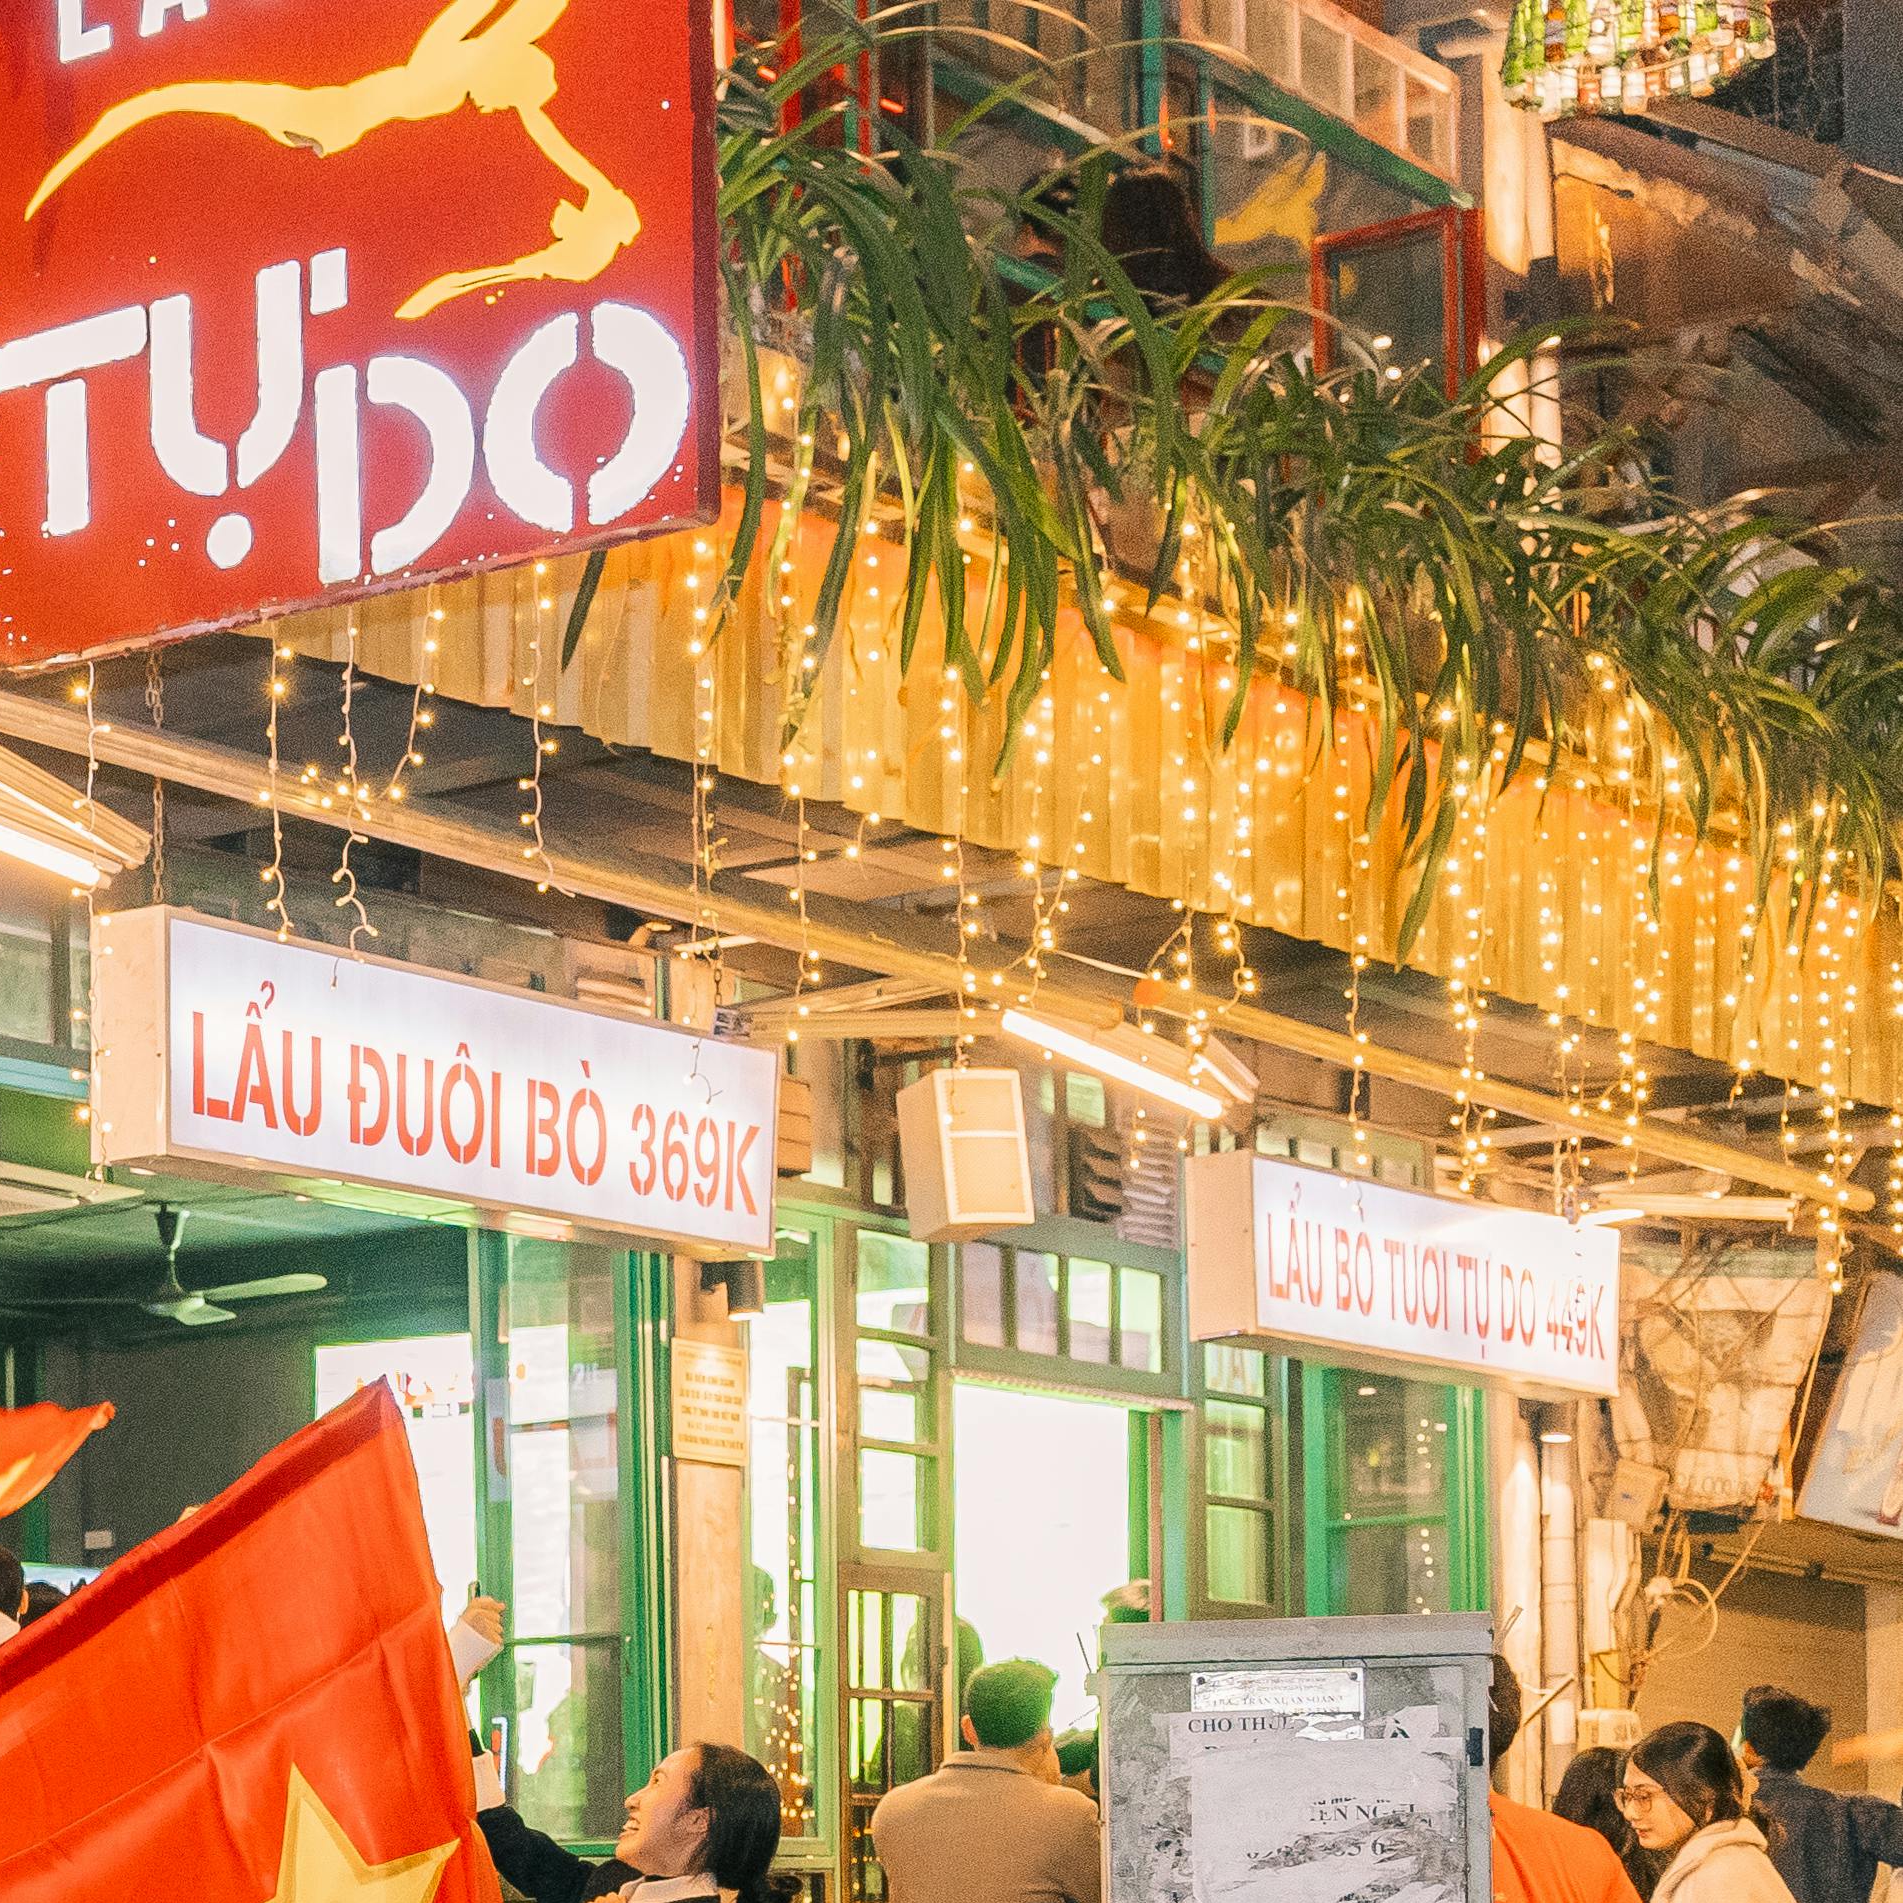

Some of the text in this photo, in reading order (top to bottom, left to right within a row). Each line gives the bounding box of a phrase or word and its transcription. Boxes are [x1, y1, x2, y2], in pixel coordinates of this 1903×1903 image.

[314, 302, 691, 584] DO
[191, 980, 761, 1216] LẨU ĐUÔI BÒ 369K
[1501, 1264, 1536, 1347] DO
[1188, 1718, 1232, 1733] CHO
